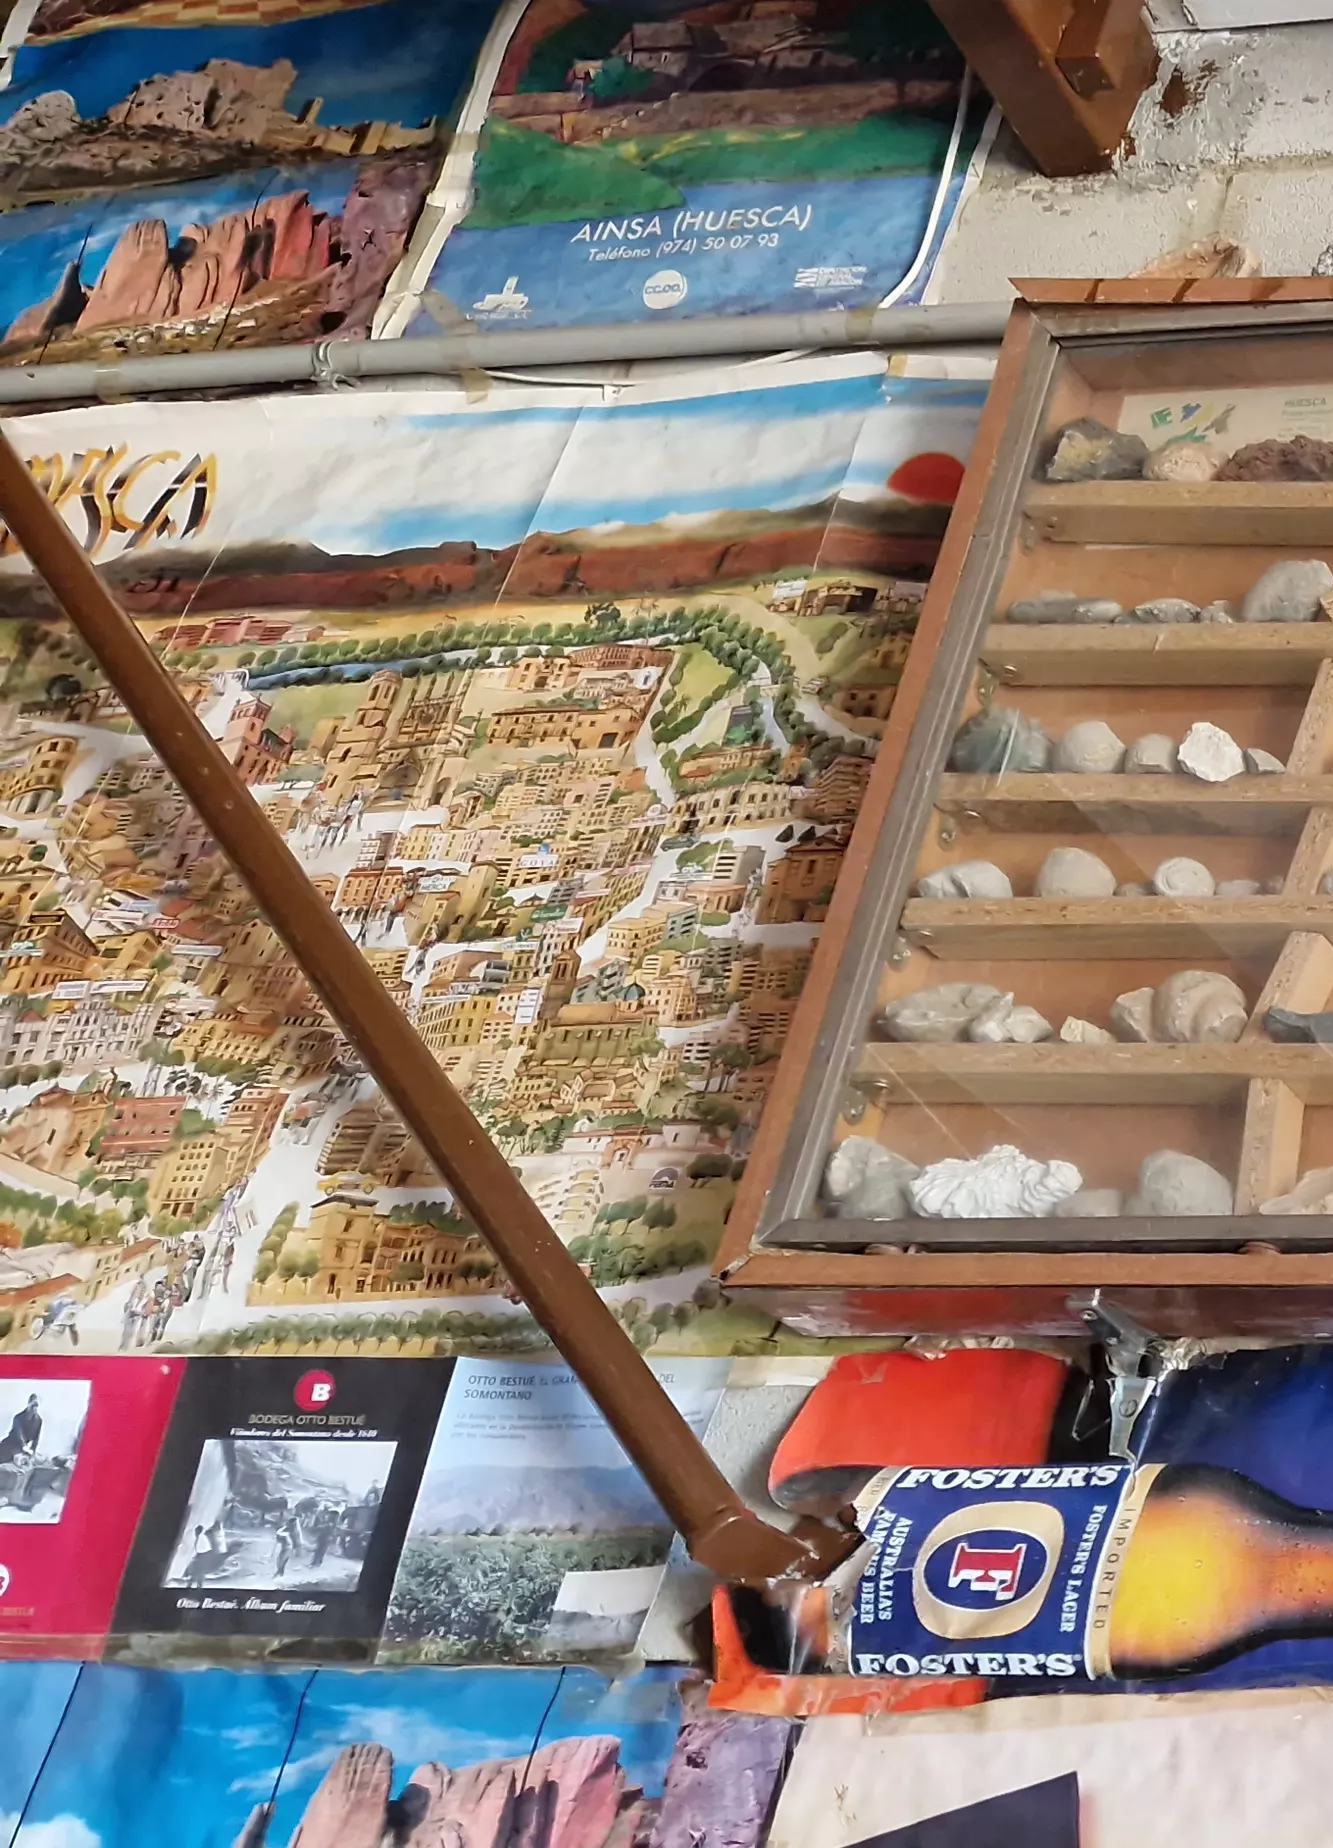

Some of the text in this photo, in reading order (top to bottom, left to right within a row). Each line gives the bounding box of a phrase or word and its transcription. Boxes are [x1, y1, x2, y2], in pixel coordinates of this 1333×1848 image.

[571, 203, 813, 244] AINSA (HUESCA)
[588, 233, 779, 263] Teléfono (974) 50 07 93
[311, 1384, 332, 1401] B
[468, 1374, 497, 1387] OTTO
[463, 1388, 532, 1401] SOMONTANO
[249, 1413, 294, 1425] BODEGA
[296, 1414, 327, 1425] OTTO
[896, 1465, 1124, 1490] FOSTER'S
[878, 1516, 914, 1621] AUSTRALIA'S
[1058, 1504, 1109, 1633] FOSTER'S LAGER
[1093, 1507, 1137, 1630] IMPORTED
[176, 1598, 200, 1609] Otto
[275, 1599, 327, 1614] familiar
[860, 1581, 875, 1625] BEER
[855, 1653, 1078, 1677] FOSTER'S
